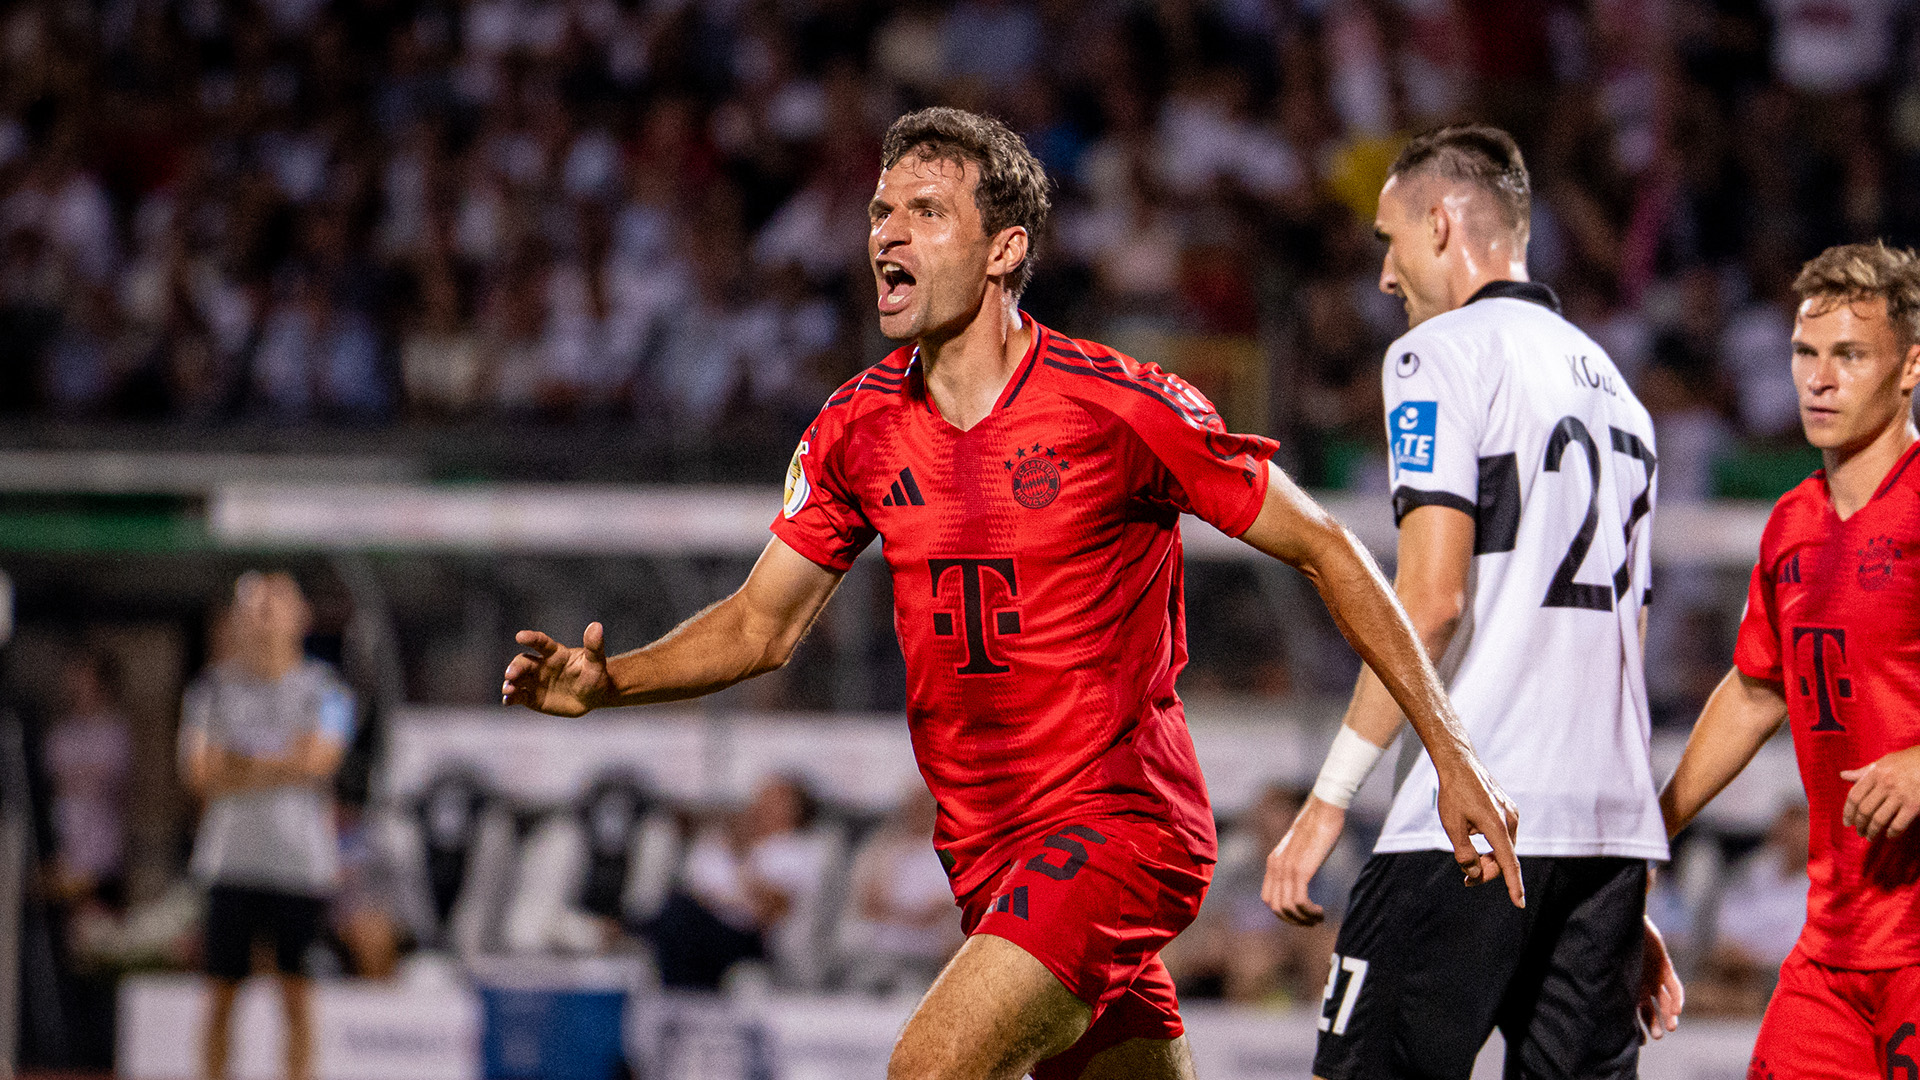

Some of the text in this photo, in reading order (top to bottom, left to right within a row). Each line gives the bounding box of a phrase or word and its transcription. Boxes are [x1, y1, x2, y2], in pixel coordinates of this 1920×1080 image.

[1540, 415, 1657, 612] 27
[927, 558, 1021, 675] T
[1793, 627, 1851, 732] T
[1317, 952, 1369, 1036] 27
[1886, 1022, 1919, 1080] 6
